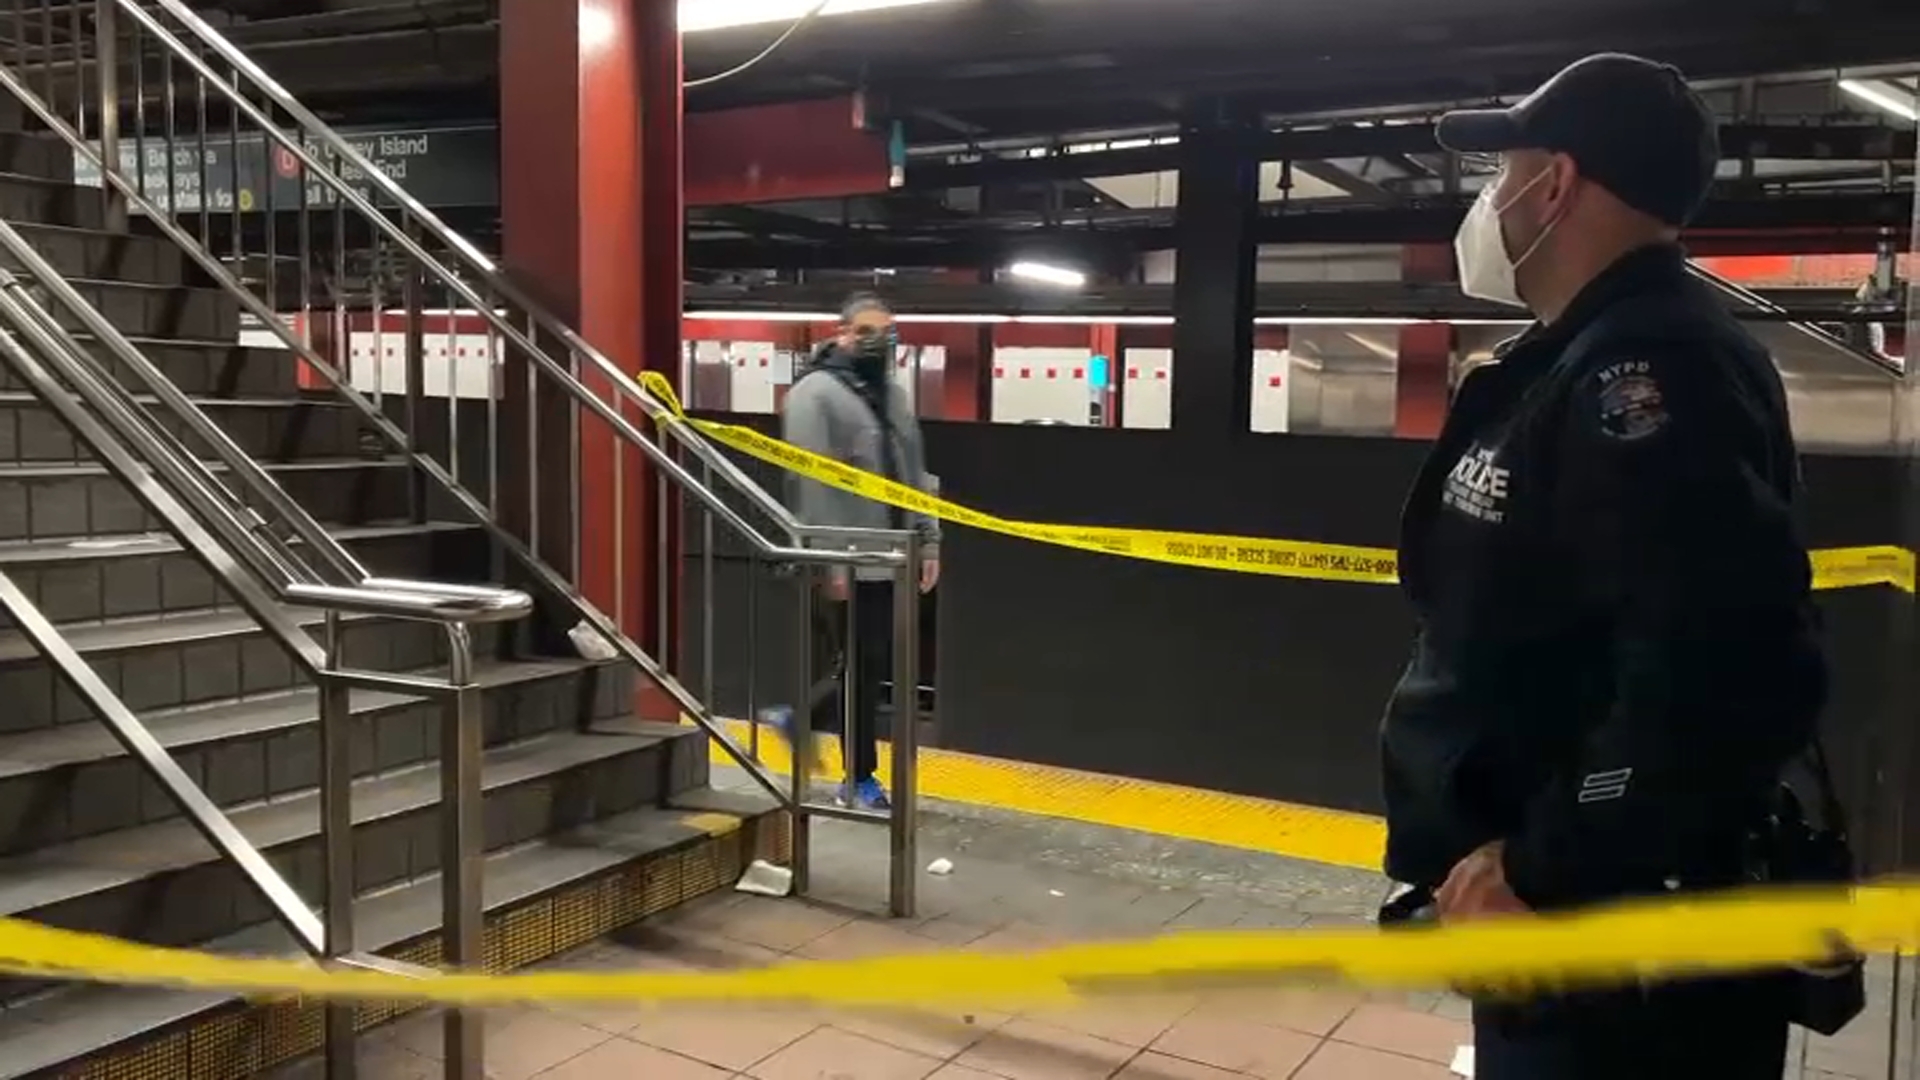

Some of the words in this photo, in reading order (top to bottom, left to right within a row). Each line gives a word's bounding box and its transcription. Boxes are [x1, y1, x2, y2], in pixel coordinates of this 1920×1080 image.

[380, 134, 428, 155] Island
[375, 159, 406, 178] End
[1598, 360, 1650, 383] NYPD
